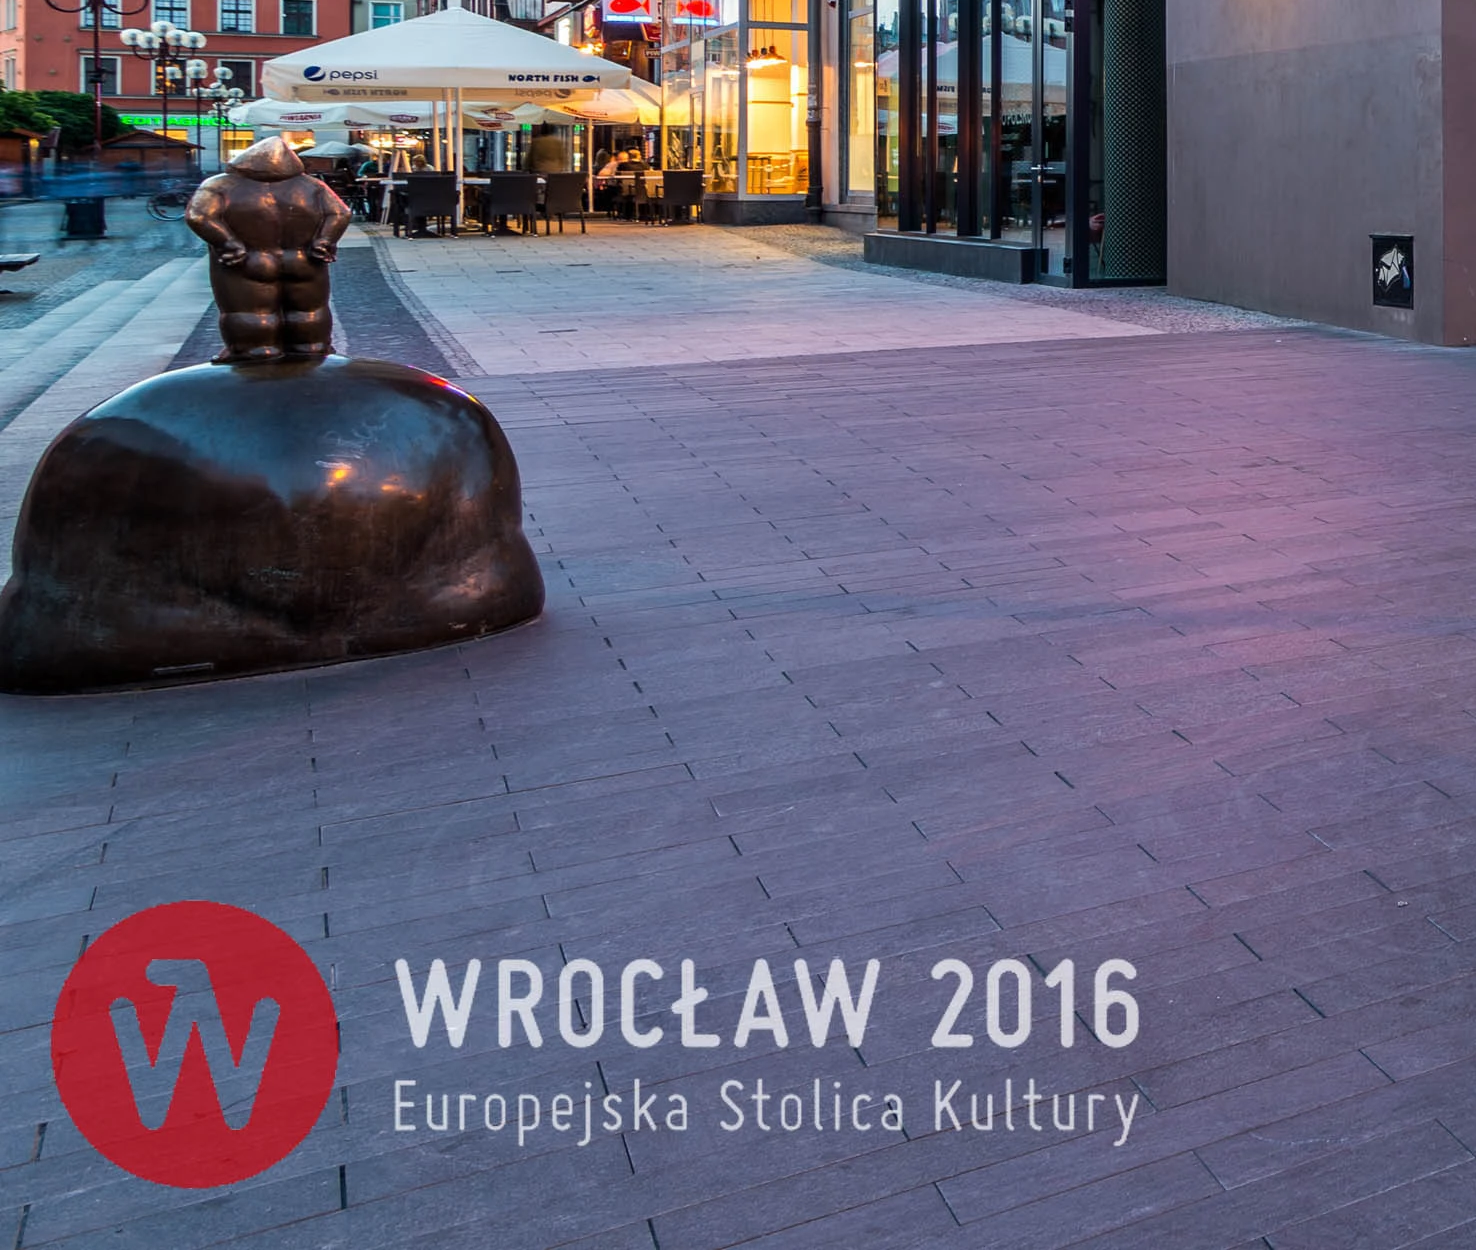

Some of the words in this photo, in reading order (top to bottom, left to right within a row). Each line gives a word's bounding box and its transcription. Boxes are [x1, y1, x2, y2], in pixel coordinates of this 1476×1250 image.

[329, 70, 379, 81] pepsi
[508, 74, 550, 82] NORTH
[553, 74, 579, 82] FISH
[121, 116, 162, 126] EDIT
